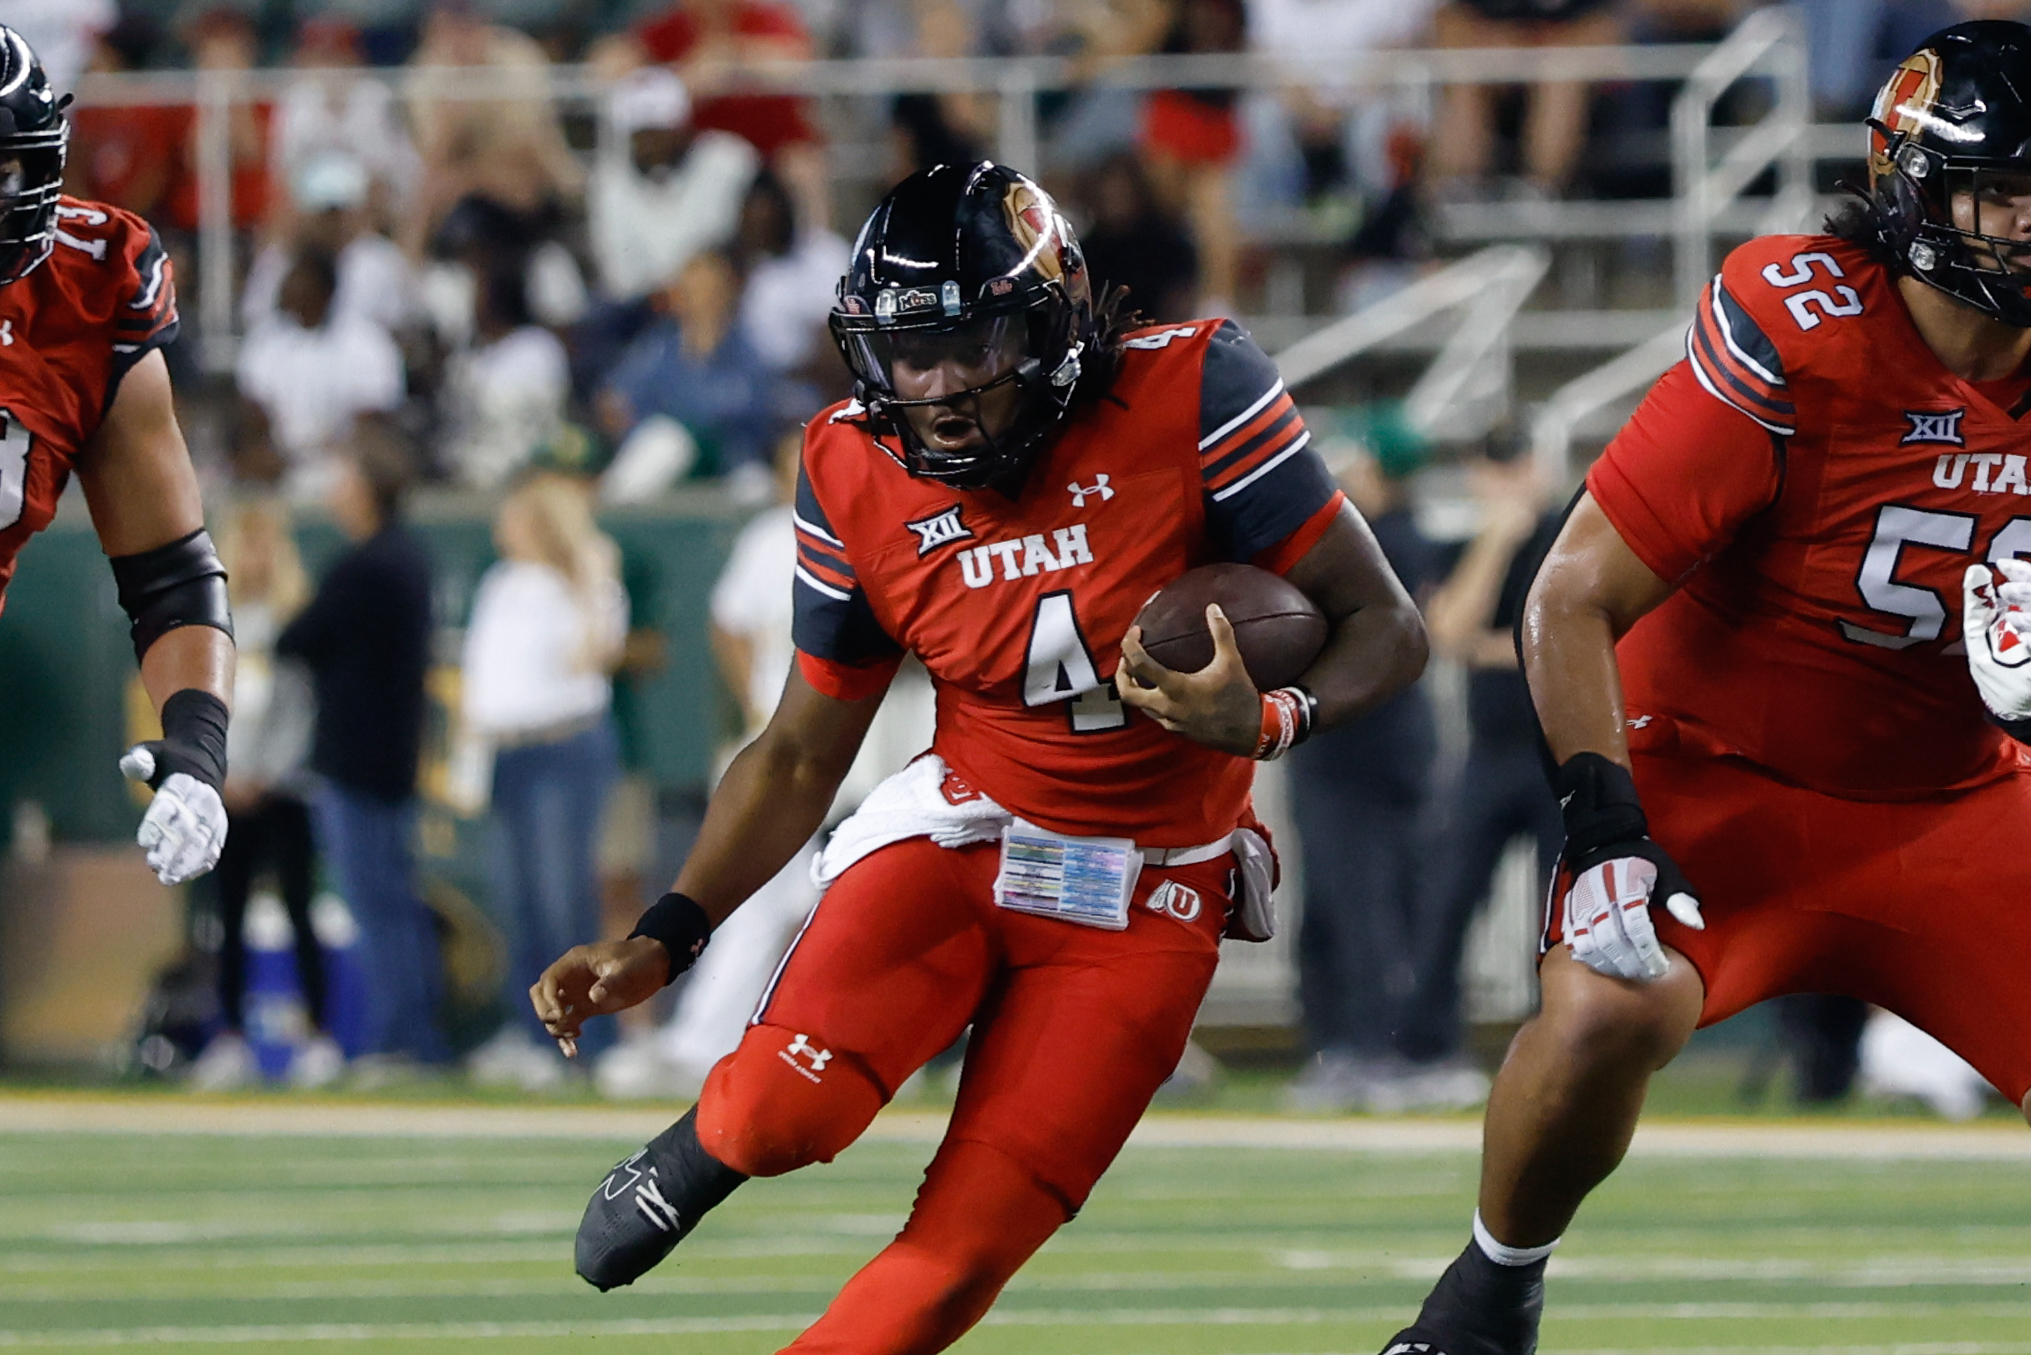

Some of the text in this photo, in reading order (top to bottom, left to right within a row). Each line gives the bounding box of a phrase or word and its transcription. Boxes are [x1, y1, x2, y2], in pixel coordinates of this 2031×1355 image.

[1761, 252, 1864, 331] 52
[1901, 410, 1964, 444] XII
[1932, 453, 2031, 496] UTA
[906, 505, 973, 556] XII
[956, 523, 1094, 589] UTAH
[1022, 589, 1128, 733] 4
